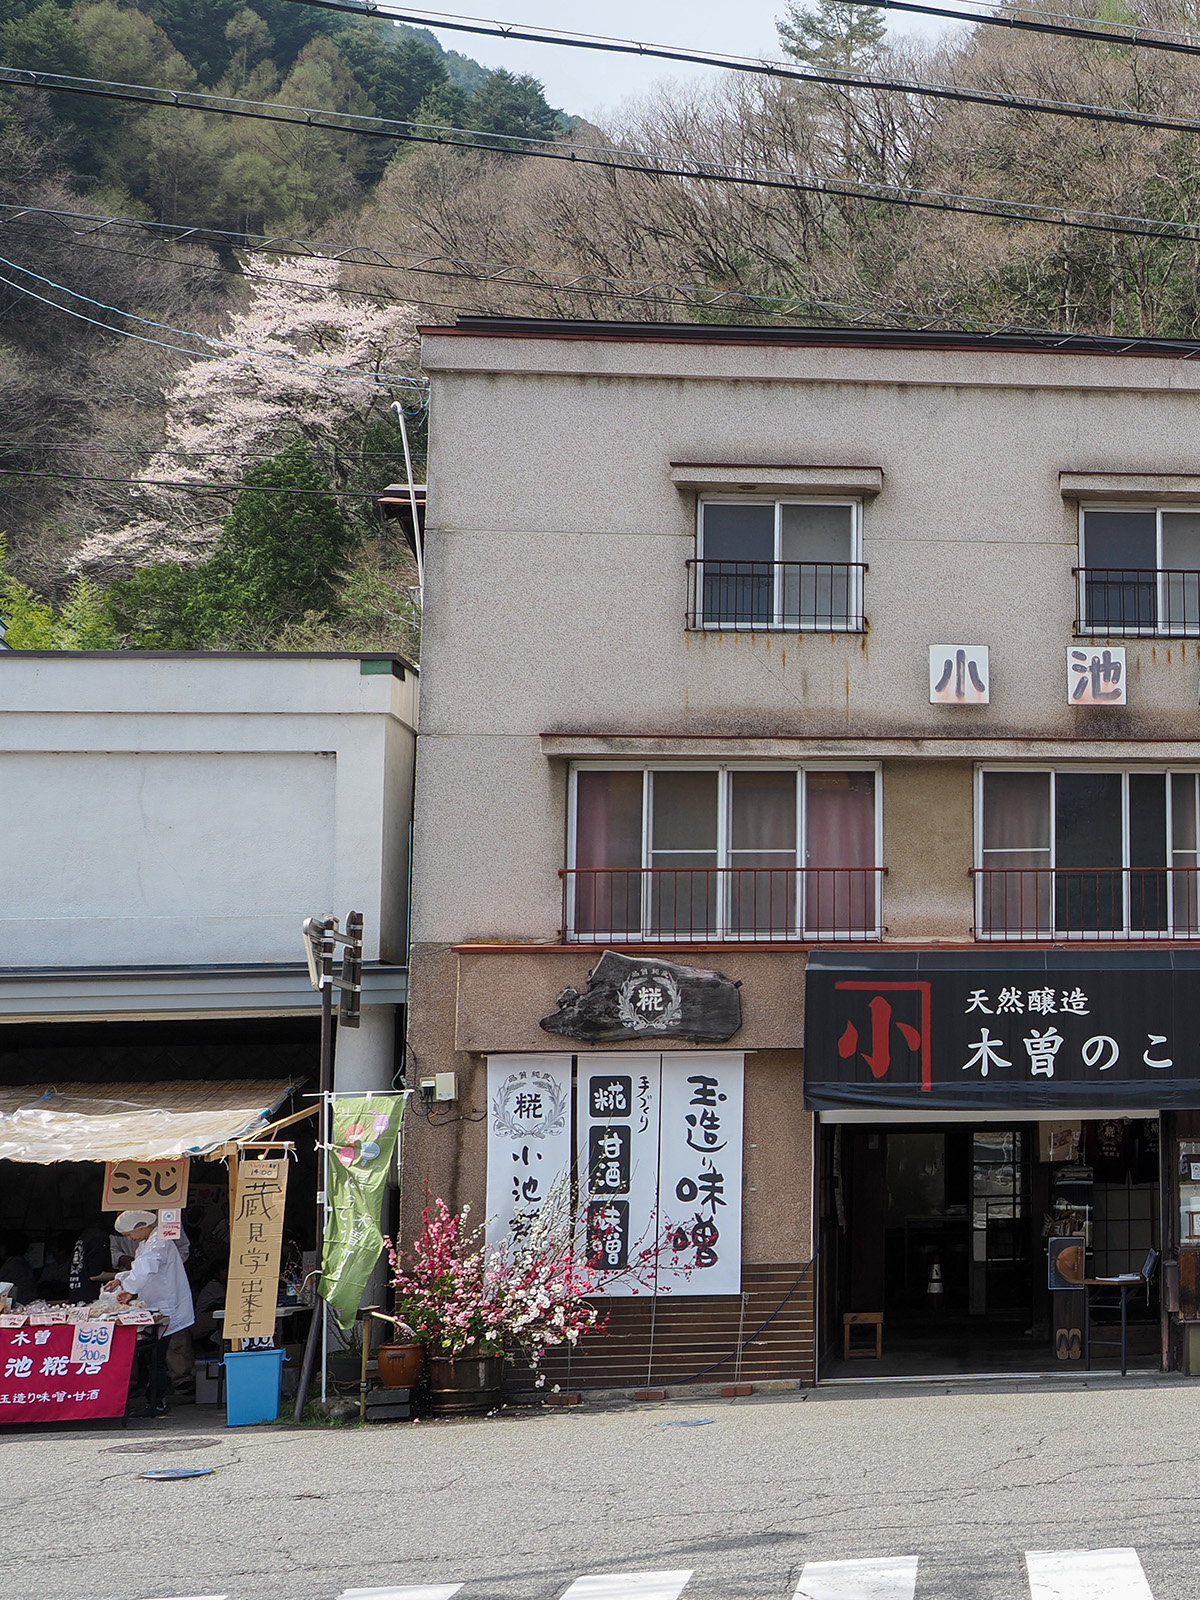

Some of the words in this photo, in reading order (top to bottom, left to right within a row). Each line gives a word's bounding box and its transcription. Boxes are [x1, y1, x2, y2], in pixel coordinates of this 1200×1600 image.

[636, 986, 664, 1012] 糀
[964, 986, 1090, 1016] 天然醸造
[513, 1092, 543, 1119] 糀
[593, 1080, 627, 1112] 糀
[636, 1075, 652, 1134] 手づくり
[597, 1131, 623, 1187] 甘酒
[674, 1075, 728, 1268] 玉造り味噌
[111, 1166, 178, 1197] こうじ
[231, 1181, 283, 1334] 蔵見学出来ます
[10, 1329, 52, 1347] 木曽
